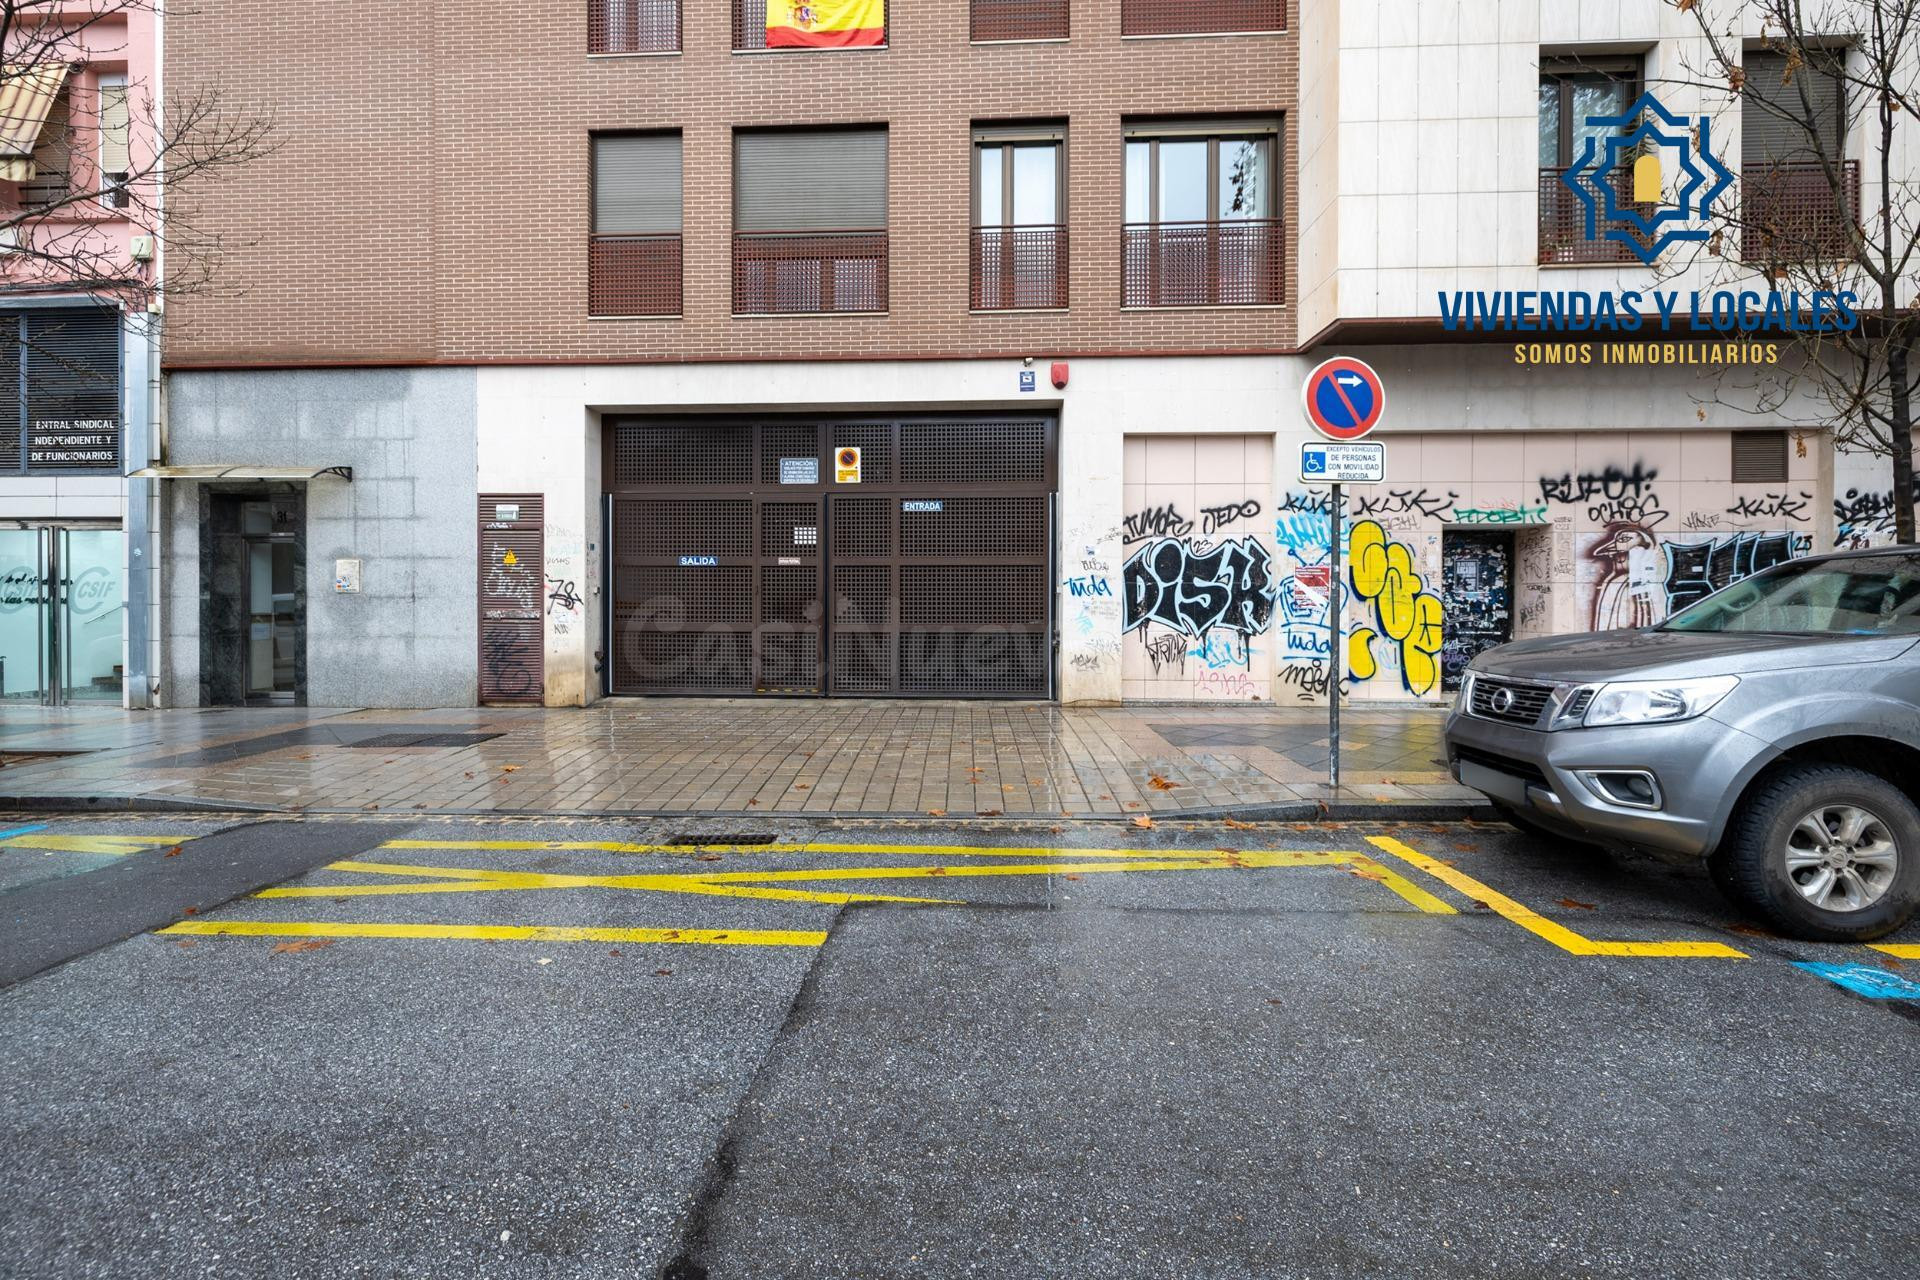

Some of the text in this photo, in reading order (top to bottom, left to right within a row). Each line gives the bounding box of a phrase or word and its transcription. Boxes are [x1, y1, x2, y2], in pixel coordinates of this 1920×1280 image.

[74, 420, 115, 429] SINDICAL
[105, 436, 112, 444] Y
[31, 451, 113, 461] DE FUNCIONARIOS
[1328, 463, 1380, 471] CON MOVILIDAD
[904, 502, 941, 511] ENTRADA
[680, 557, 717, 566] SALIDA
